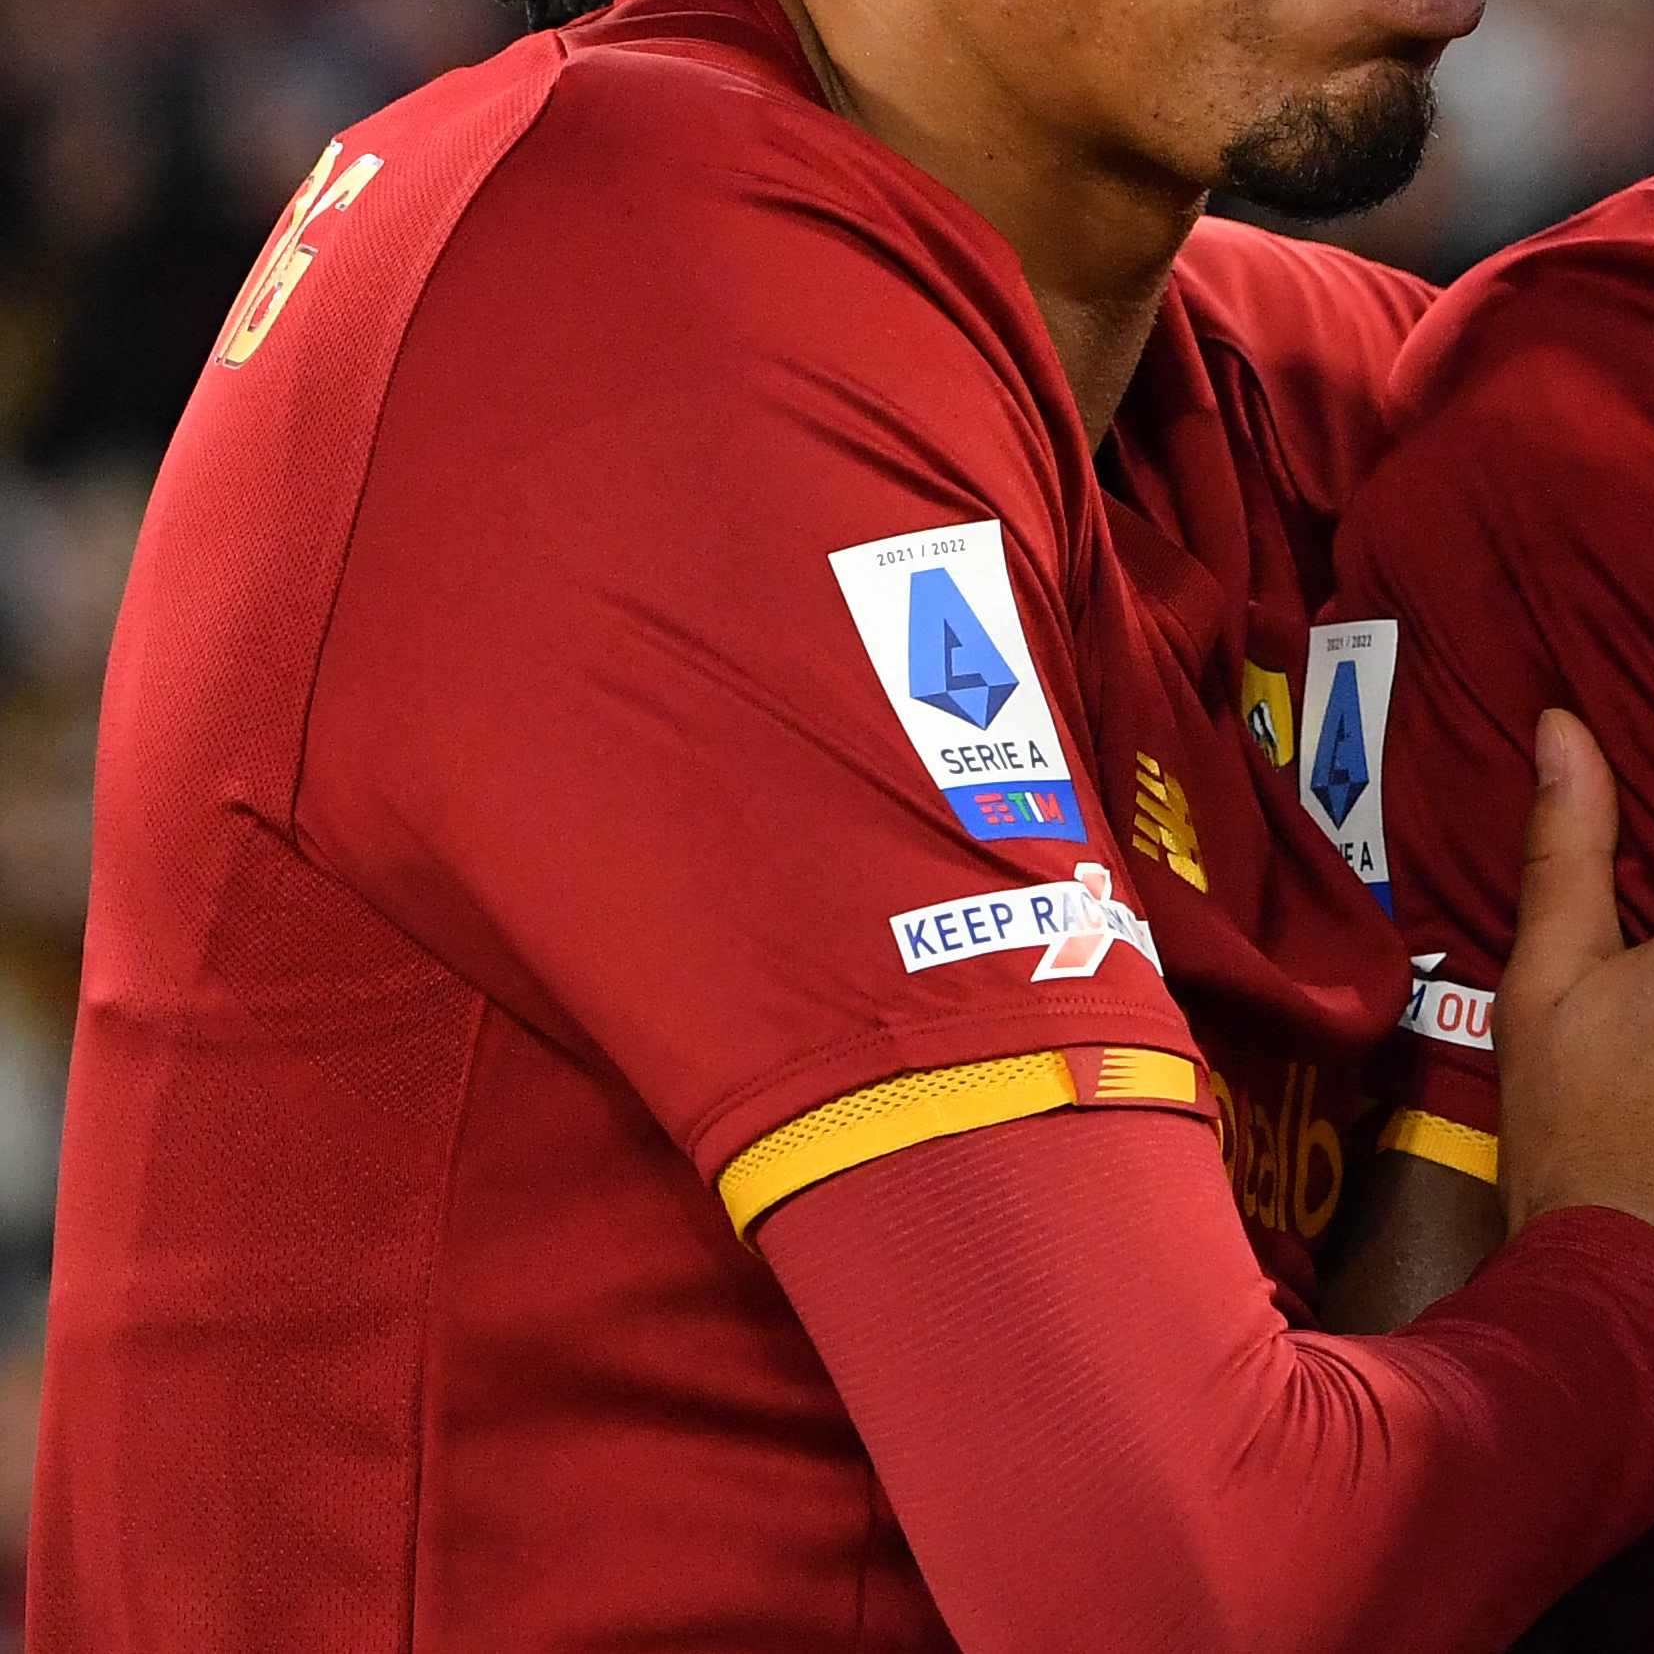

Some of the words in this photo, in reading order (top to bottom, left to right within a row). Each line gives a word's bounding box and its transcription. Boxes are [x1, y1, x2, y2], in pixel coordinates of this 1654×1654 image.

[876, 547, 915, 567] 2021
[931, 538, 967, 556] 2022
[940, 742, 1024, 774] SERIE
[1030, 740, 1049, 769] A
[1007, 792, 1066, 825] TIM
[904, 902, 1014, 959] KEEP
